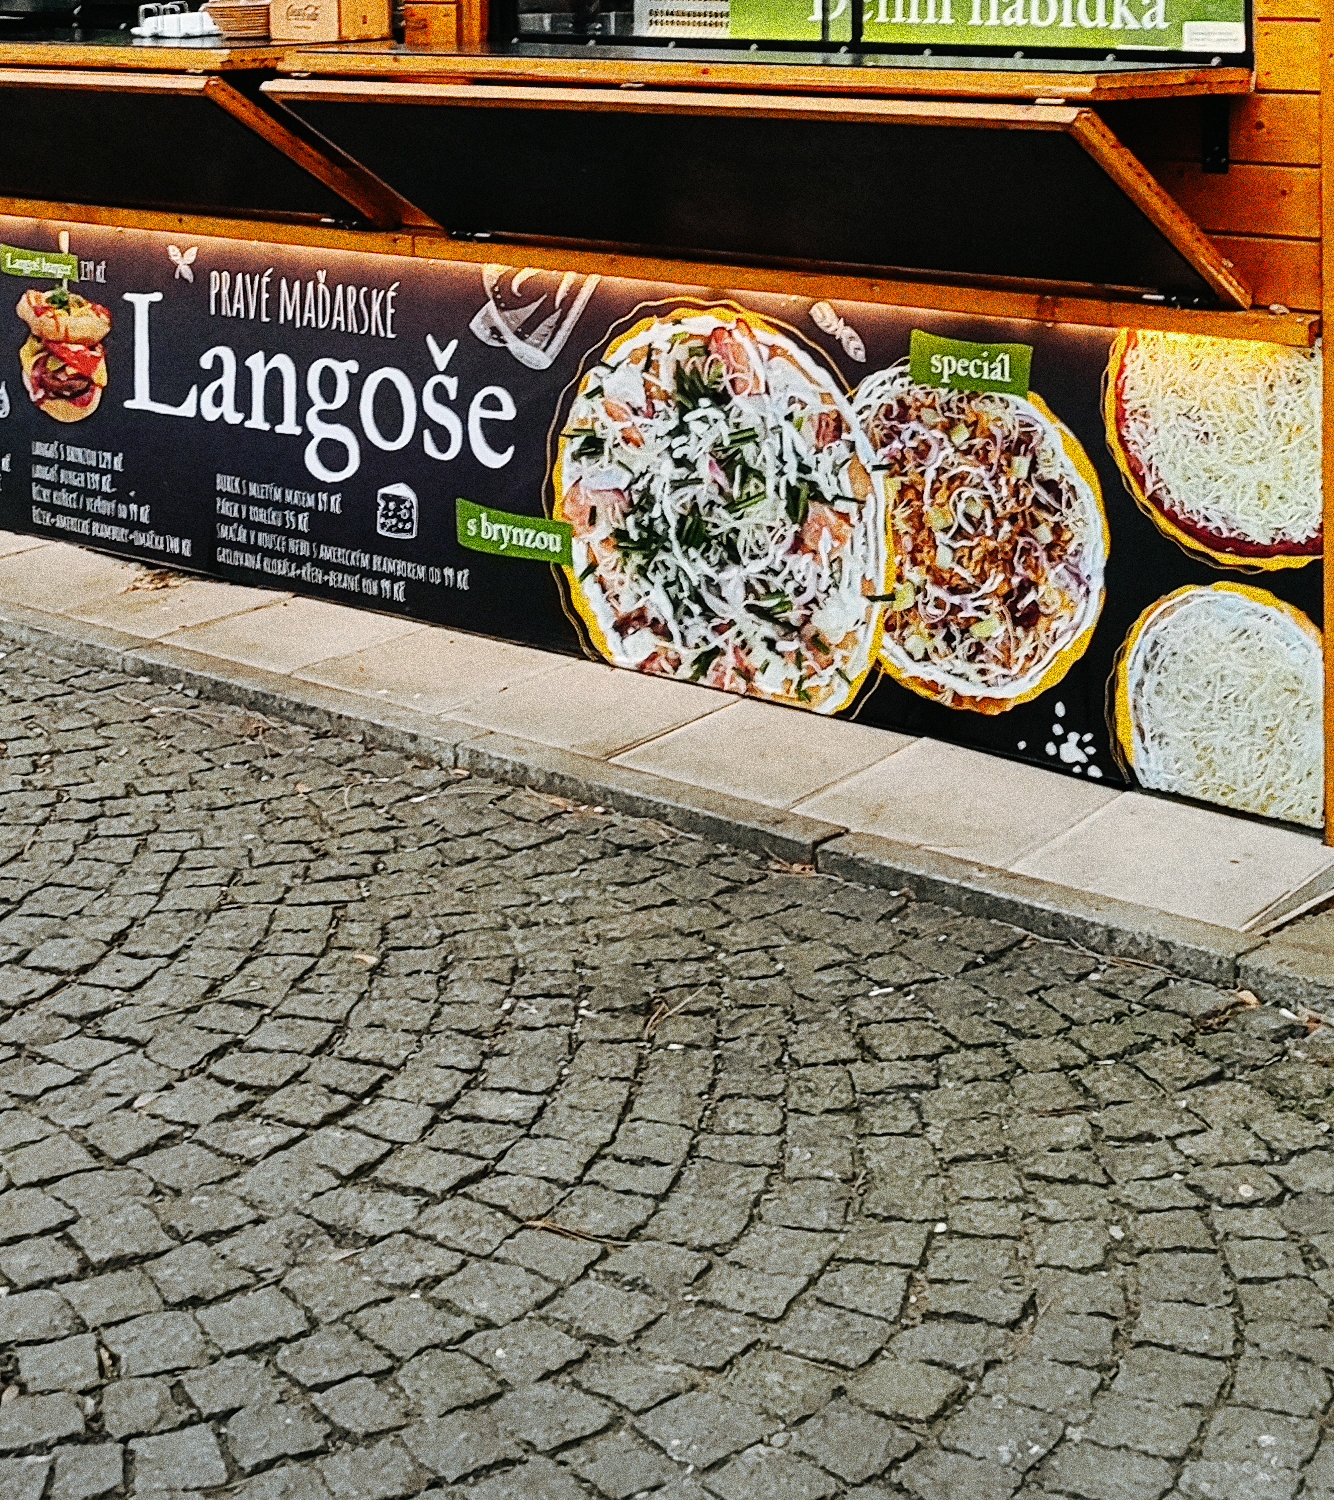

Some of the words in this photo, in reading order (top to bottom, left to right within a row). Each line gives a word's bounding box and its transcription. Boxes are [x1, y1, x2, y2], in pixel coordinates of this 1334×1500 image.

[209, 268, 274, 323] PRAVÉ
[279, 268, 399, 340] MAĎARSKÉ
[123, 291, 517, 484] Langoše
[930, 350, 1011, 383] speciál
[284, 509, 296, 530] 35
[466, 518, 477, 537] s
[480, 512, 563, 556] brynzou
